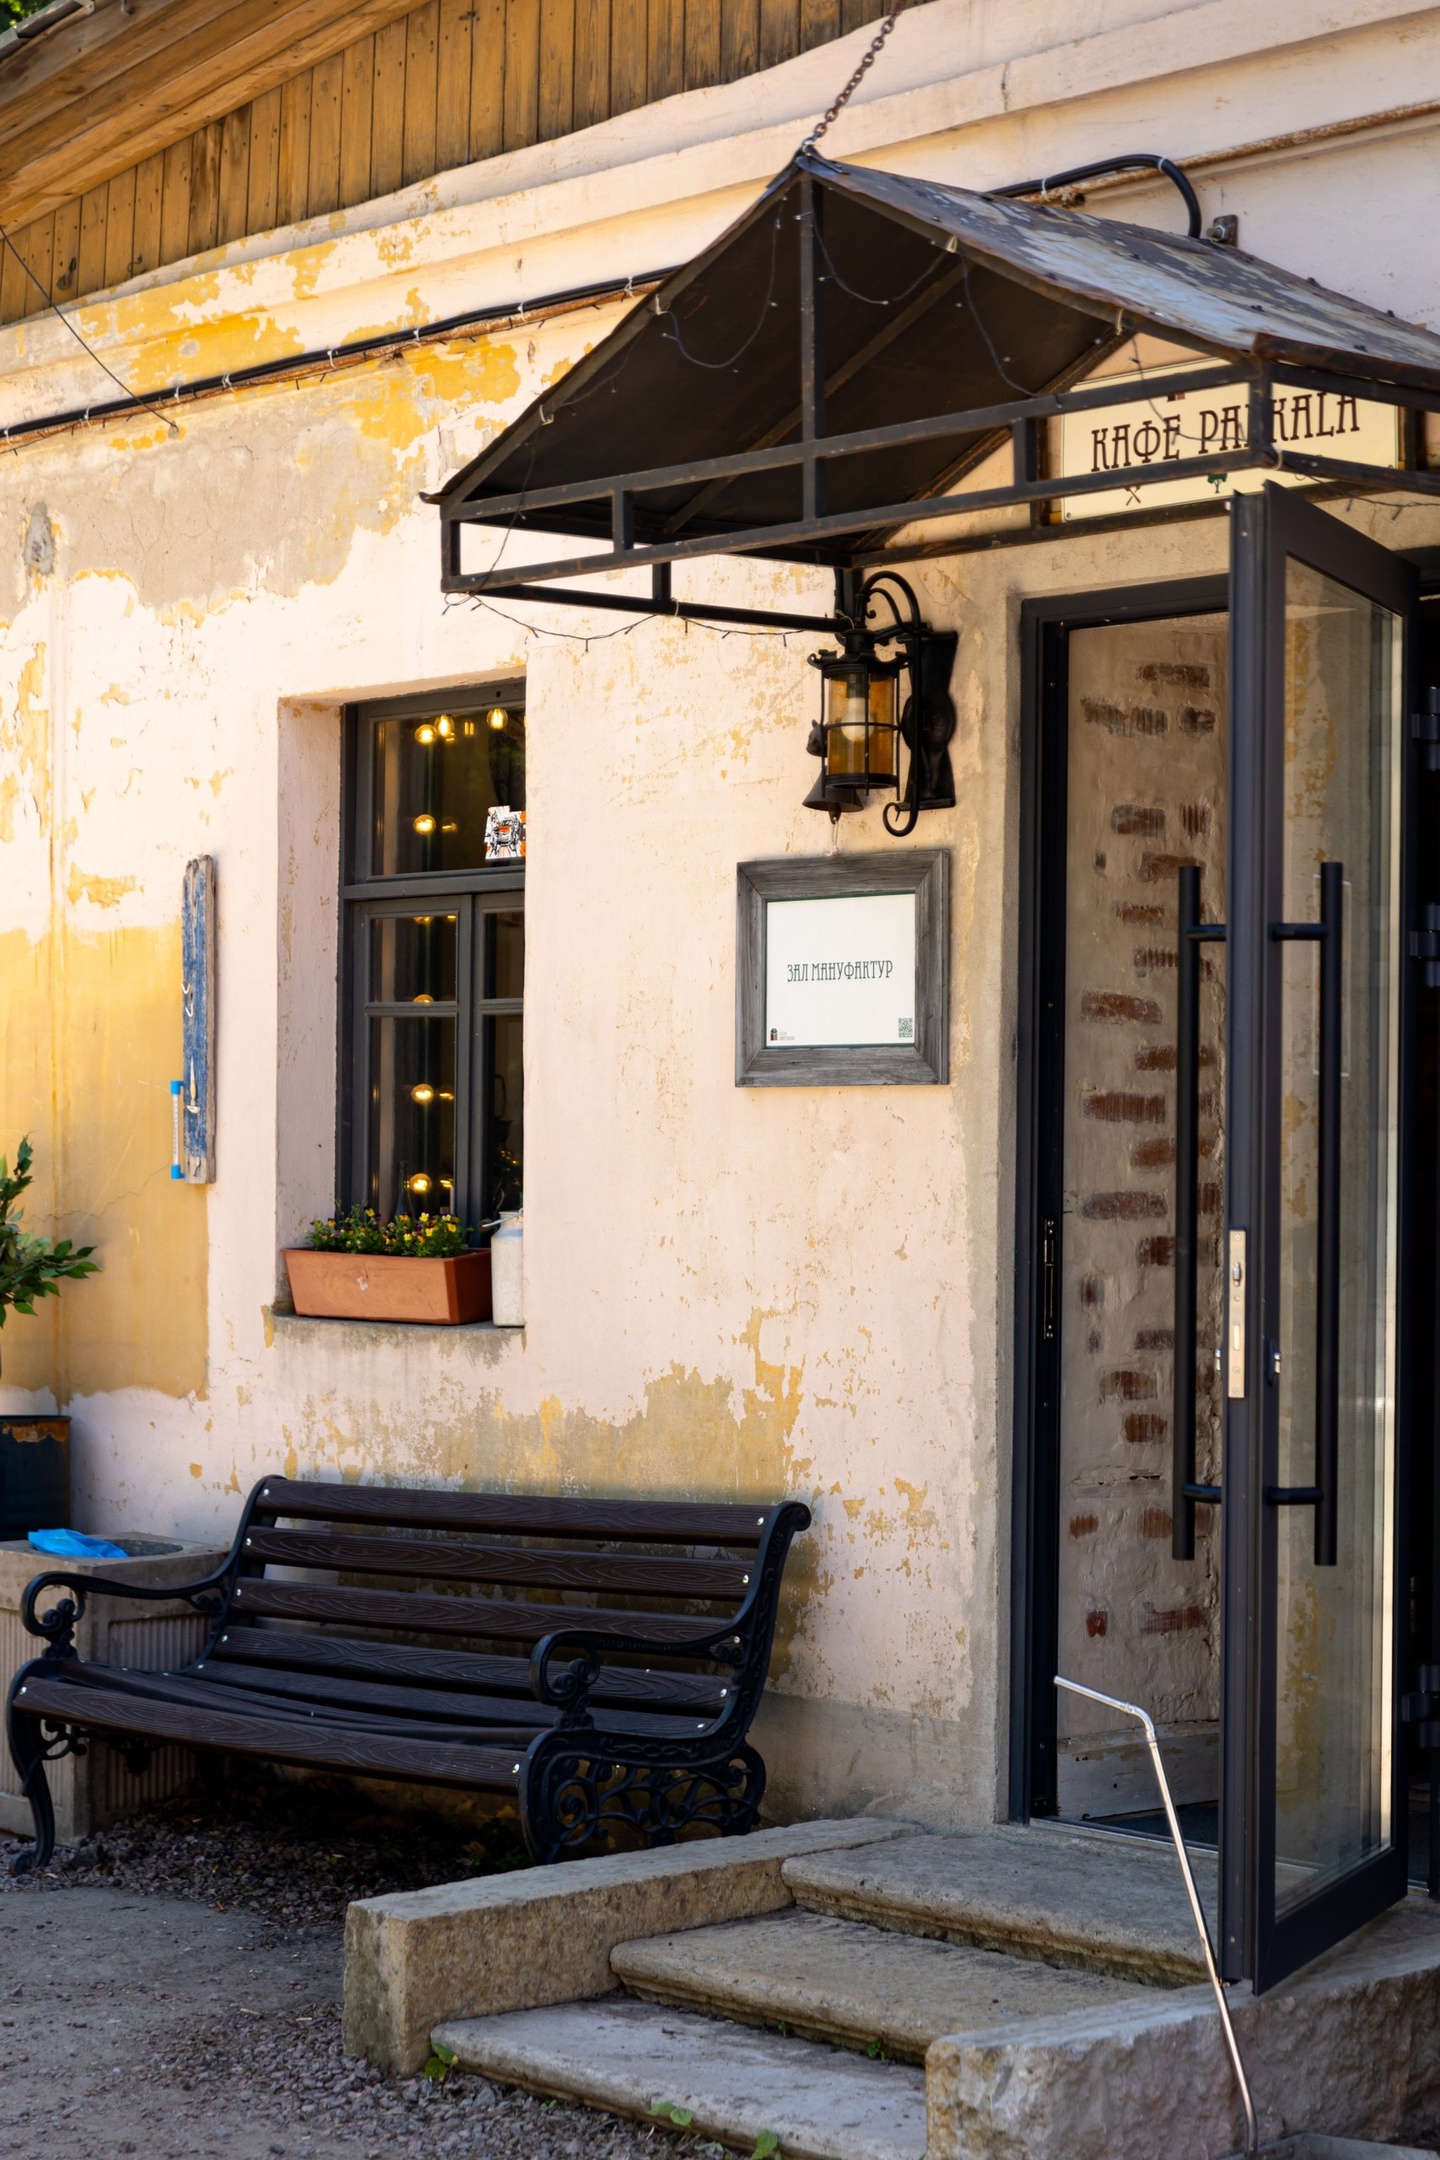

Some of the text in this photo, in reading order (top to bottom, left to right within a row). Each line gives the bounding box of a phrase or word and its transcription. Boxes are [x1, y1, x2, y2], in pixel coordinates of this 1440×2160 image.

[1091, 391, 1361, 472] КАФЕ PAKALA
[787, 959, 894, 983] ЗАЛ МАНУФАКТУР
